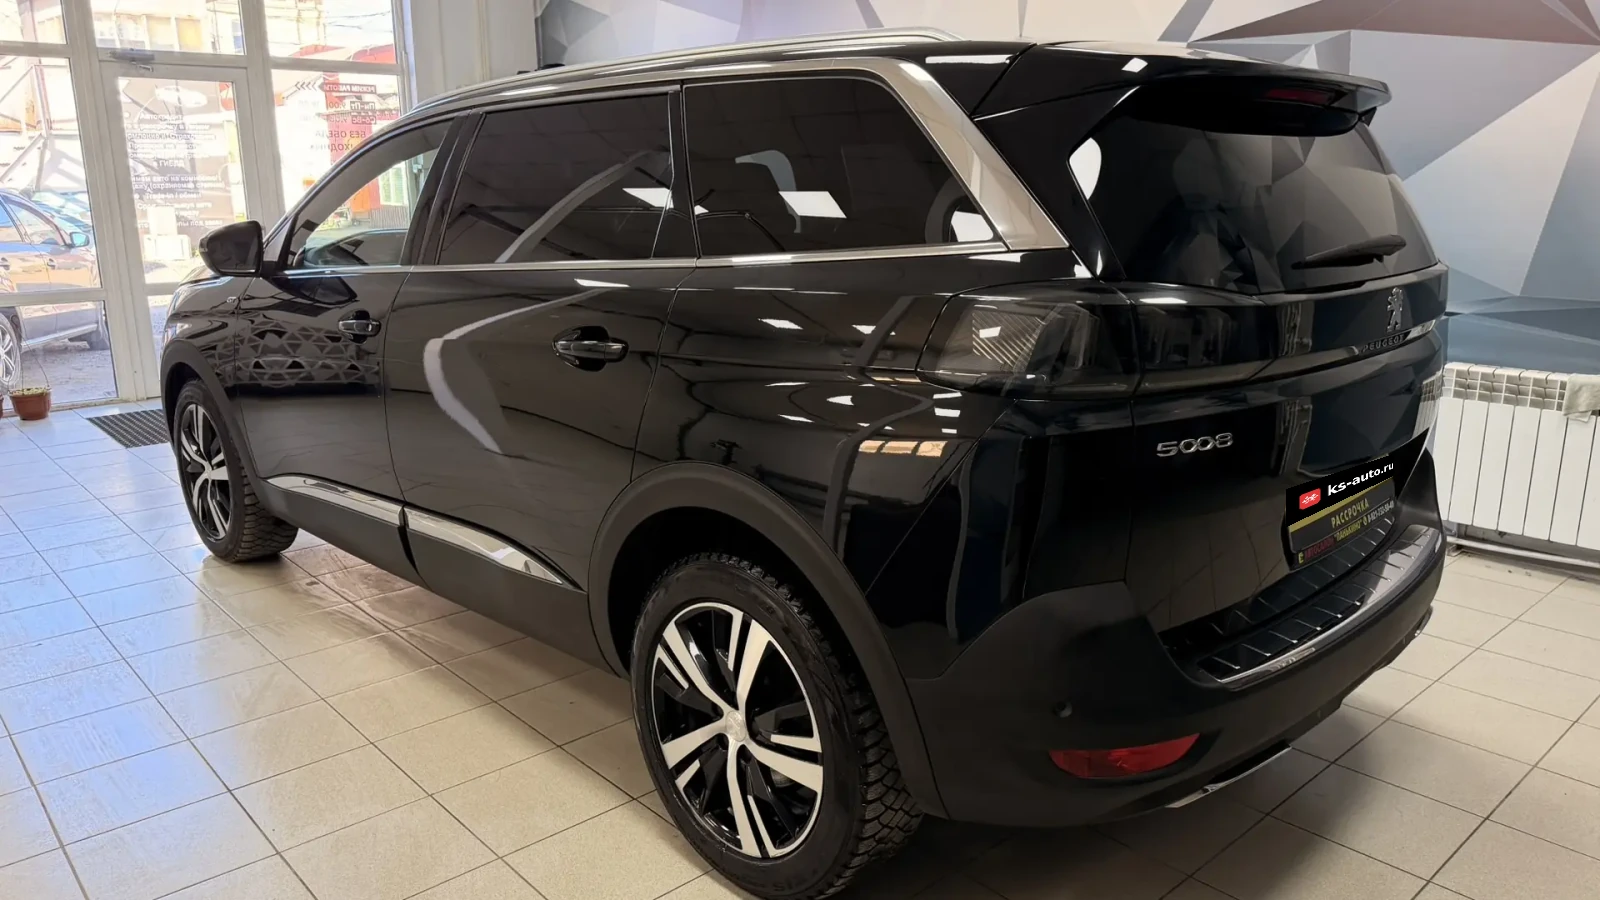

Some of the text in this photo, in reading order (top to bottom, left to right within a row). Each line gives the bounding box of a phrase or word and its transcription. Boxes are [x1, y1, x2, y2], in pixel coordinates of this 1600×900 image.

[1362, 333, 1404, 354] PEUGEOT
[1156, 432, 1234, 458] 5008
[1330, 497, 1370, 529] РАССРОЧКА
